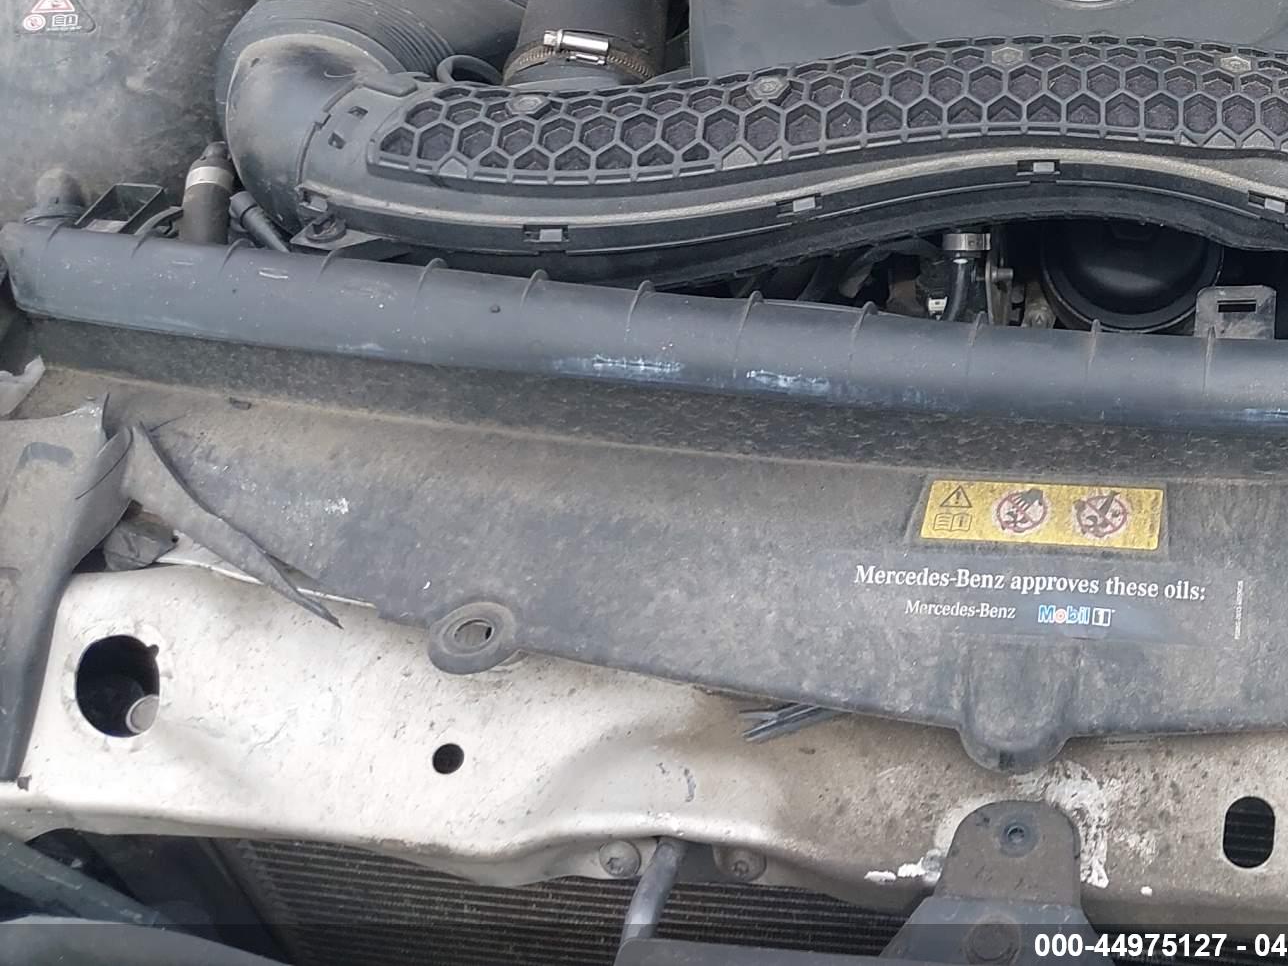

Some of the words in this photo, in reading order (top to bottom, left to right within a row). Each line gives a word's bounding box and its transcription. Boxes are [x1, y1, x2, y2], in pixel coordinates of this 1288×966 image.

[853, 565, 1006, 590] Mercedes-Benz
[1010, 575, 1100, 595] approves
[1105, 579, 1160, 598] these
[1163, 581, 1207, 600] oils:
[904, 599, 1016, 619] Mercedes-Benz
[1037, 604, 1090, 625] Mobil
